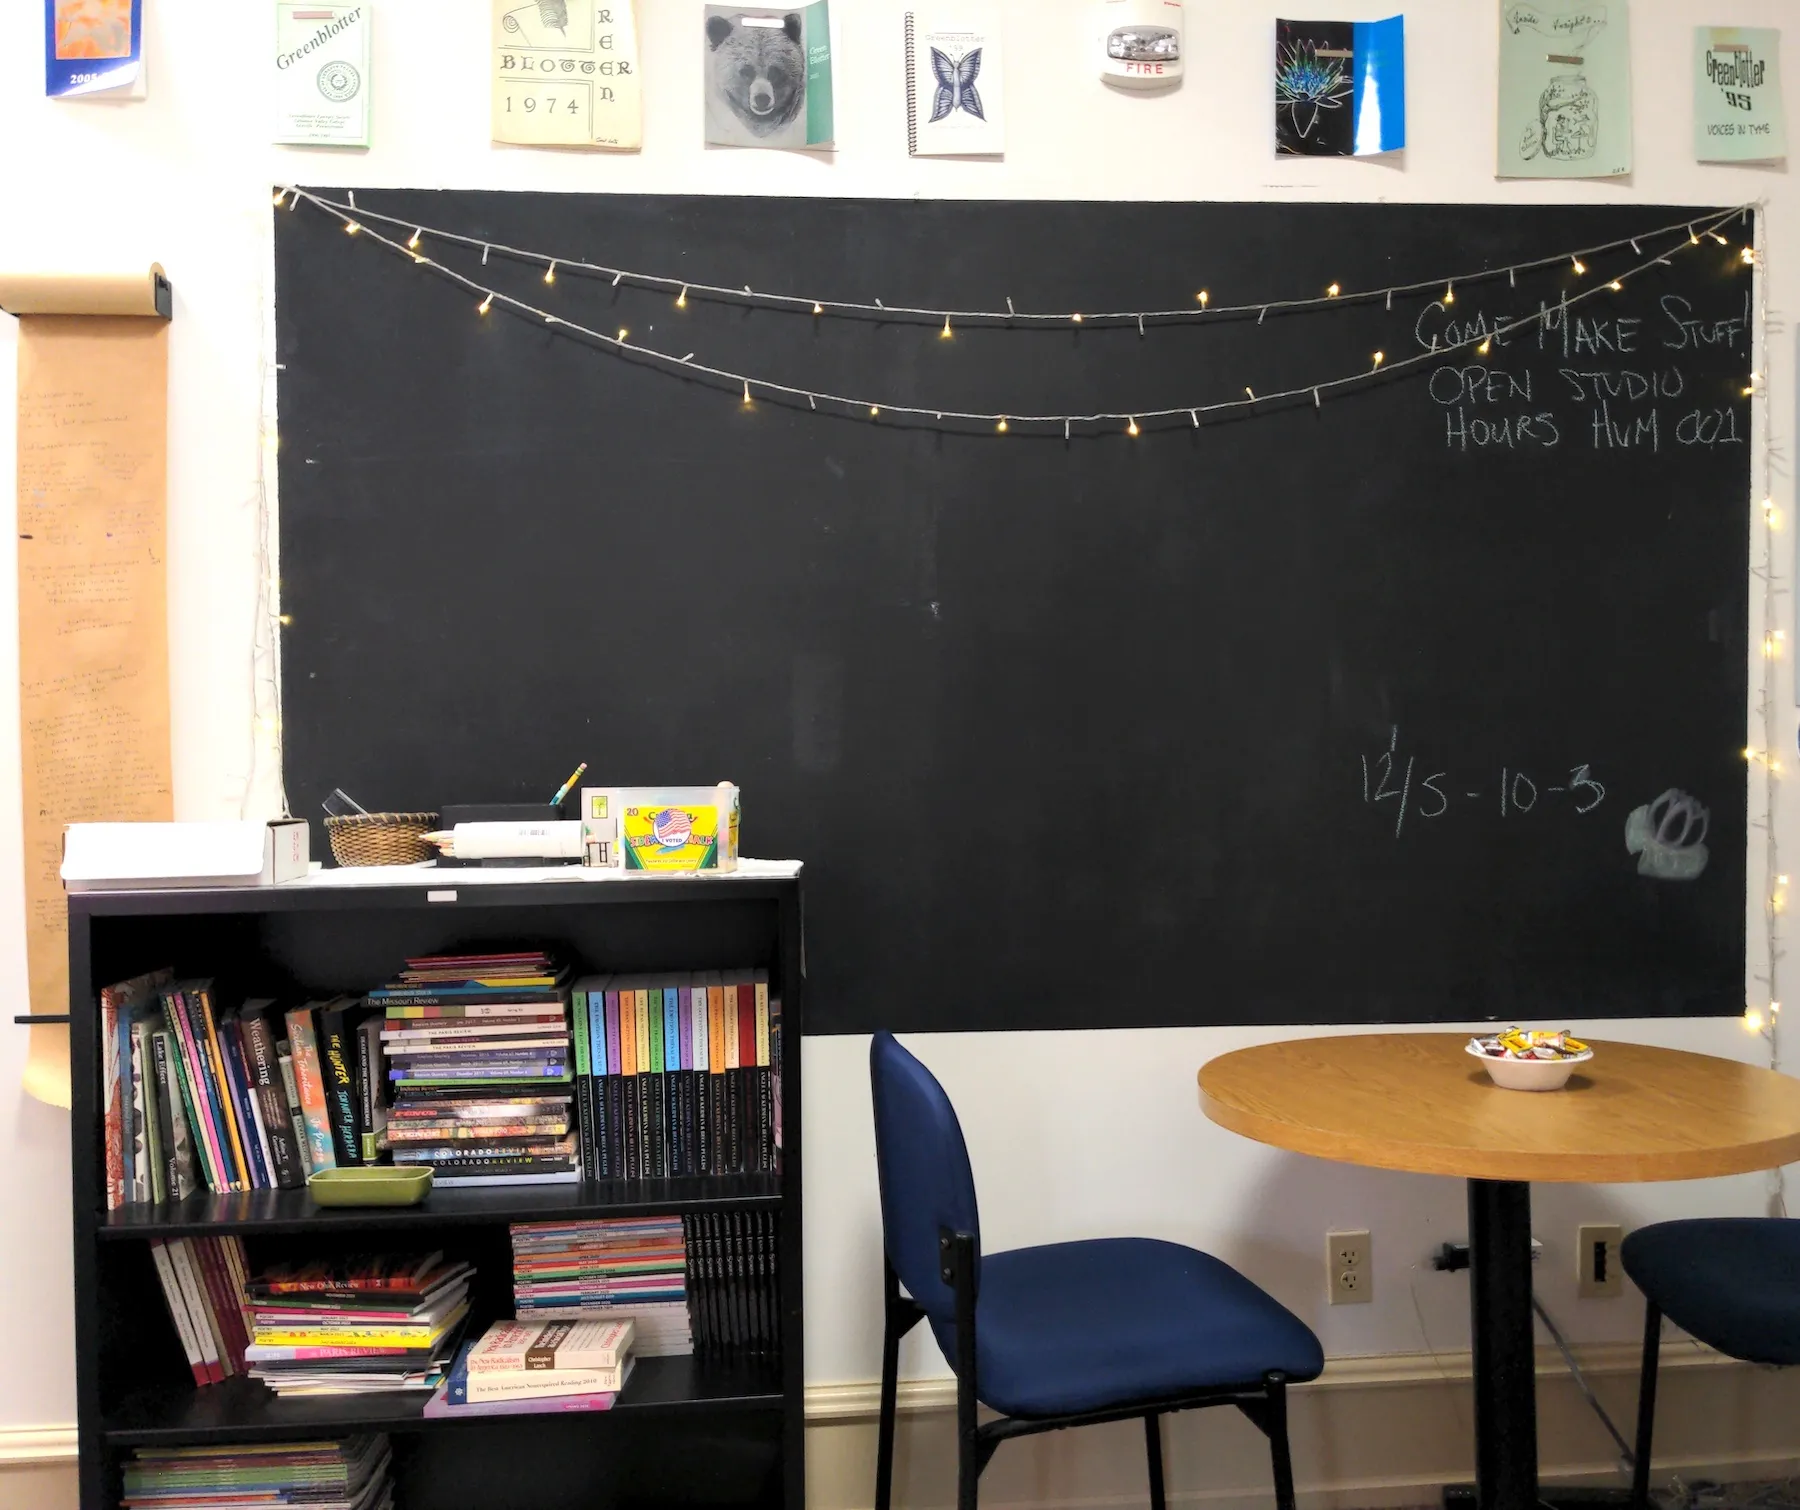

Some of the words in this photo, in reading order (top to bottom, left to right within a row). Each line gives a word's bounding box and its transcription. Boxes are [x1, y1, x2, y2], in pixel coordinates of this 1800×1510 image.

[276, 7, 361, 70] Greenblotter
[1126, 62, 1164, 74] FIRE
[505, 97, 580, 115] 1974
[1707, 123, 1734, 136] VOICES
[1414, 300, 1513, 354] COME
[1538, 289, 1642, 359] MAKE
[1428, 365, 1533, 405] OPEN
[1557, 366, 1685, 402] STUDIO
[1445, 405, 1561, 451] HOURS
[1592, 399, 1659, 453] HUM
[626, 808, 639, 816] 20
[413, 996, 440, 1005] Review
[156, 1041, 164, 1059] Lake
[304, 1044, 313, 1057] The
[330, 1034, 340, 1049] THE
[250, 1017, 270, 1086] Weathering
[158, 1060, 167, 1084] Effect
[290, 1024, 304, 1057] Sicilian
[297, 1059, 313, 1105] Inheritance
[327, 1050, 350, 1085] HUNTER
[336, 1090, 354, 1124] JENNIFER
[310, 1118, 321, 1128] Jo
[432, 1158, 490, 1166] COLORADO
[434, 1148, 492, 1158] COLORADO
[168, 1157, 176, 1185] Volume
[171, 1187, 179, 1196] 21
[526, 1381, 560, 1389] Nonrequired
